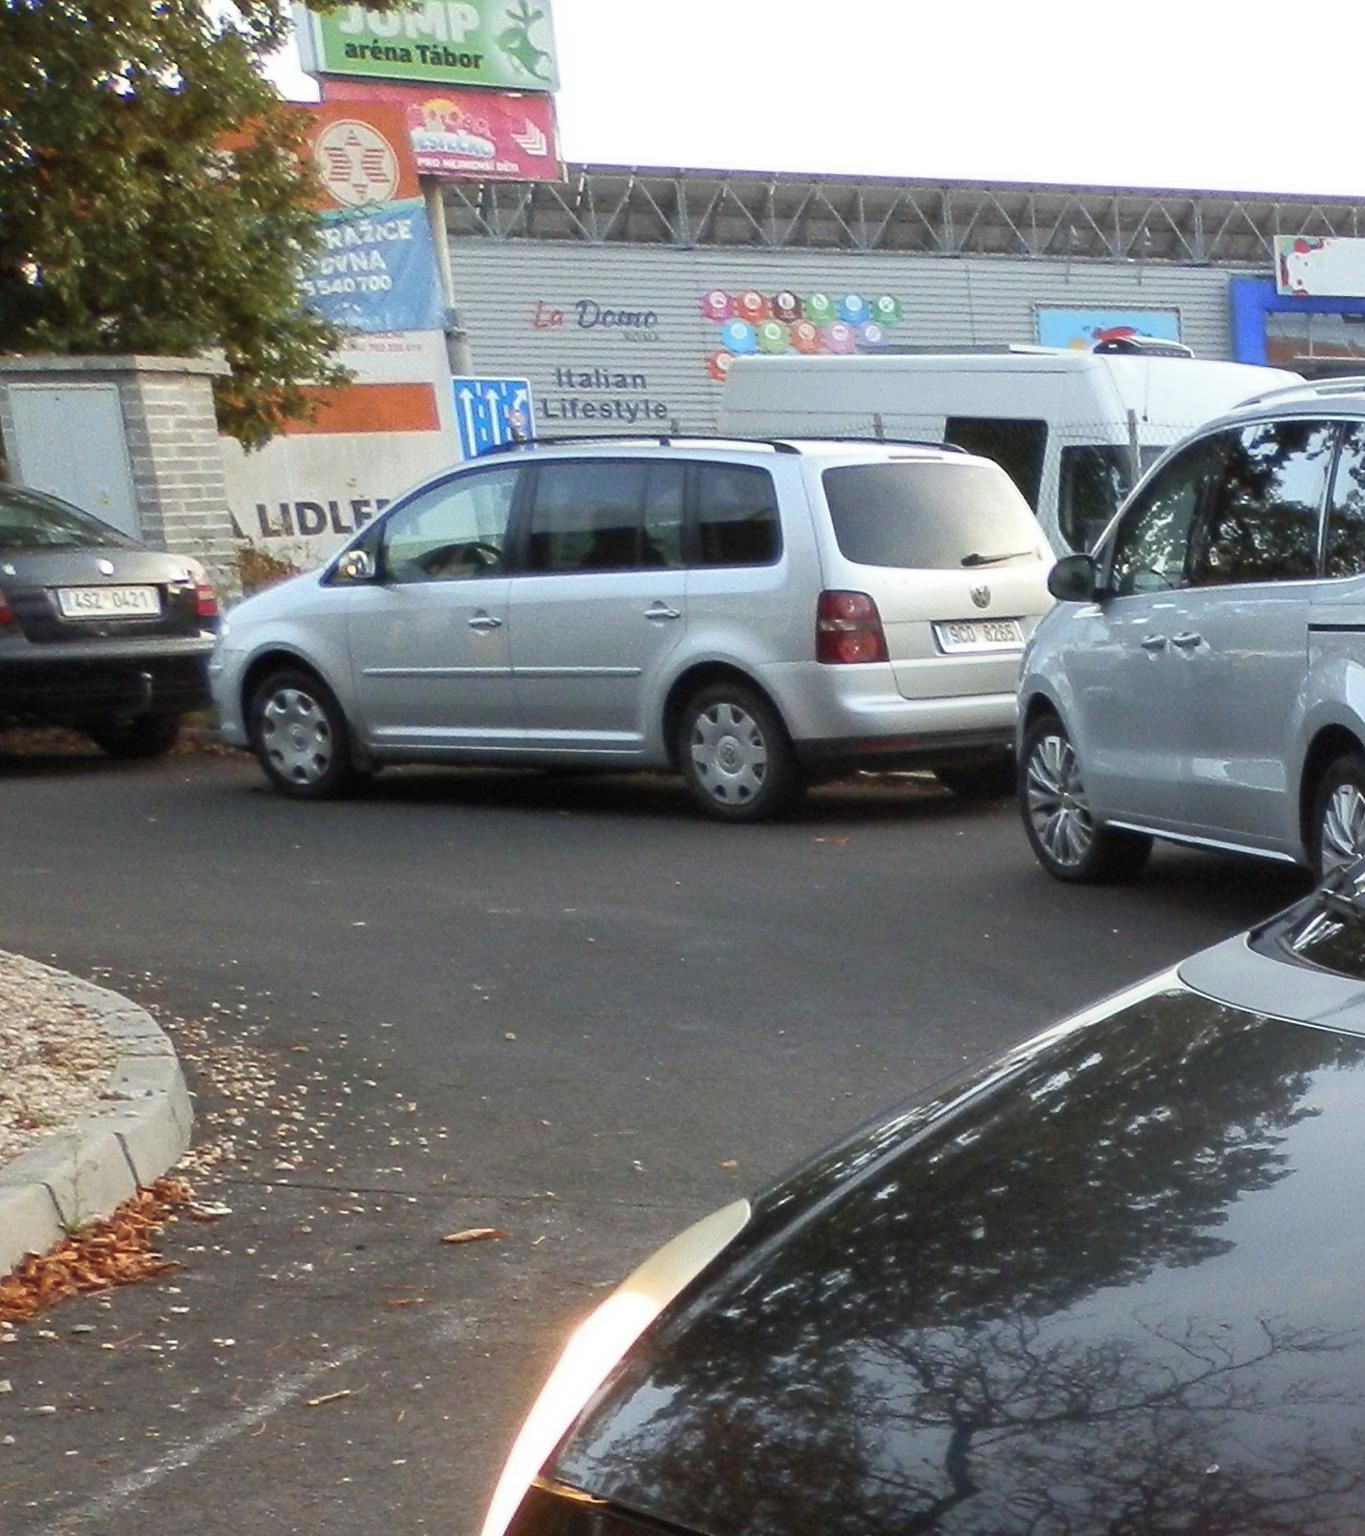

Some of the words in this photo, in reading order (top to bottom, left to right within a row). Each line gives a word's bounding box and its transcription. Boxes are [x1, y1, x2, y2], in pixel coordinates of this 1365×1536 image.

[338, 2, 480, 43] JUMP
[345, 40, 412, 62] aréna
[416, 43, 484, 69] Tábor
[319, 218, 413, 249] RAŽICE
[532, 299, 564, 329] La
[575, 299, 658, 329] Domo
[552, 368, 648, 388] Italian
[541, 398, 668, 424] Lifestyle
[256, 499, 390, 538] LIDLE
